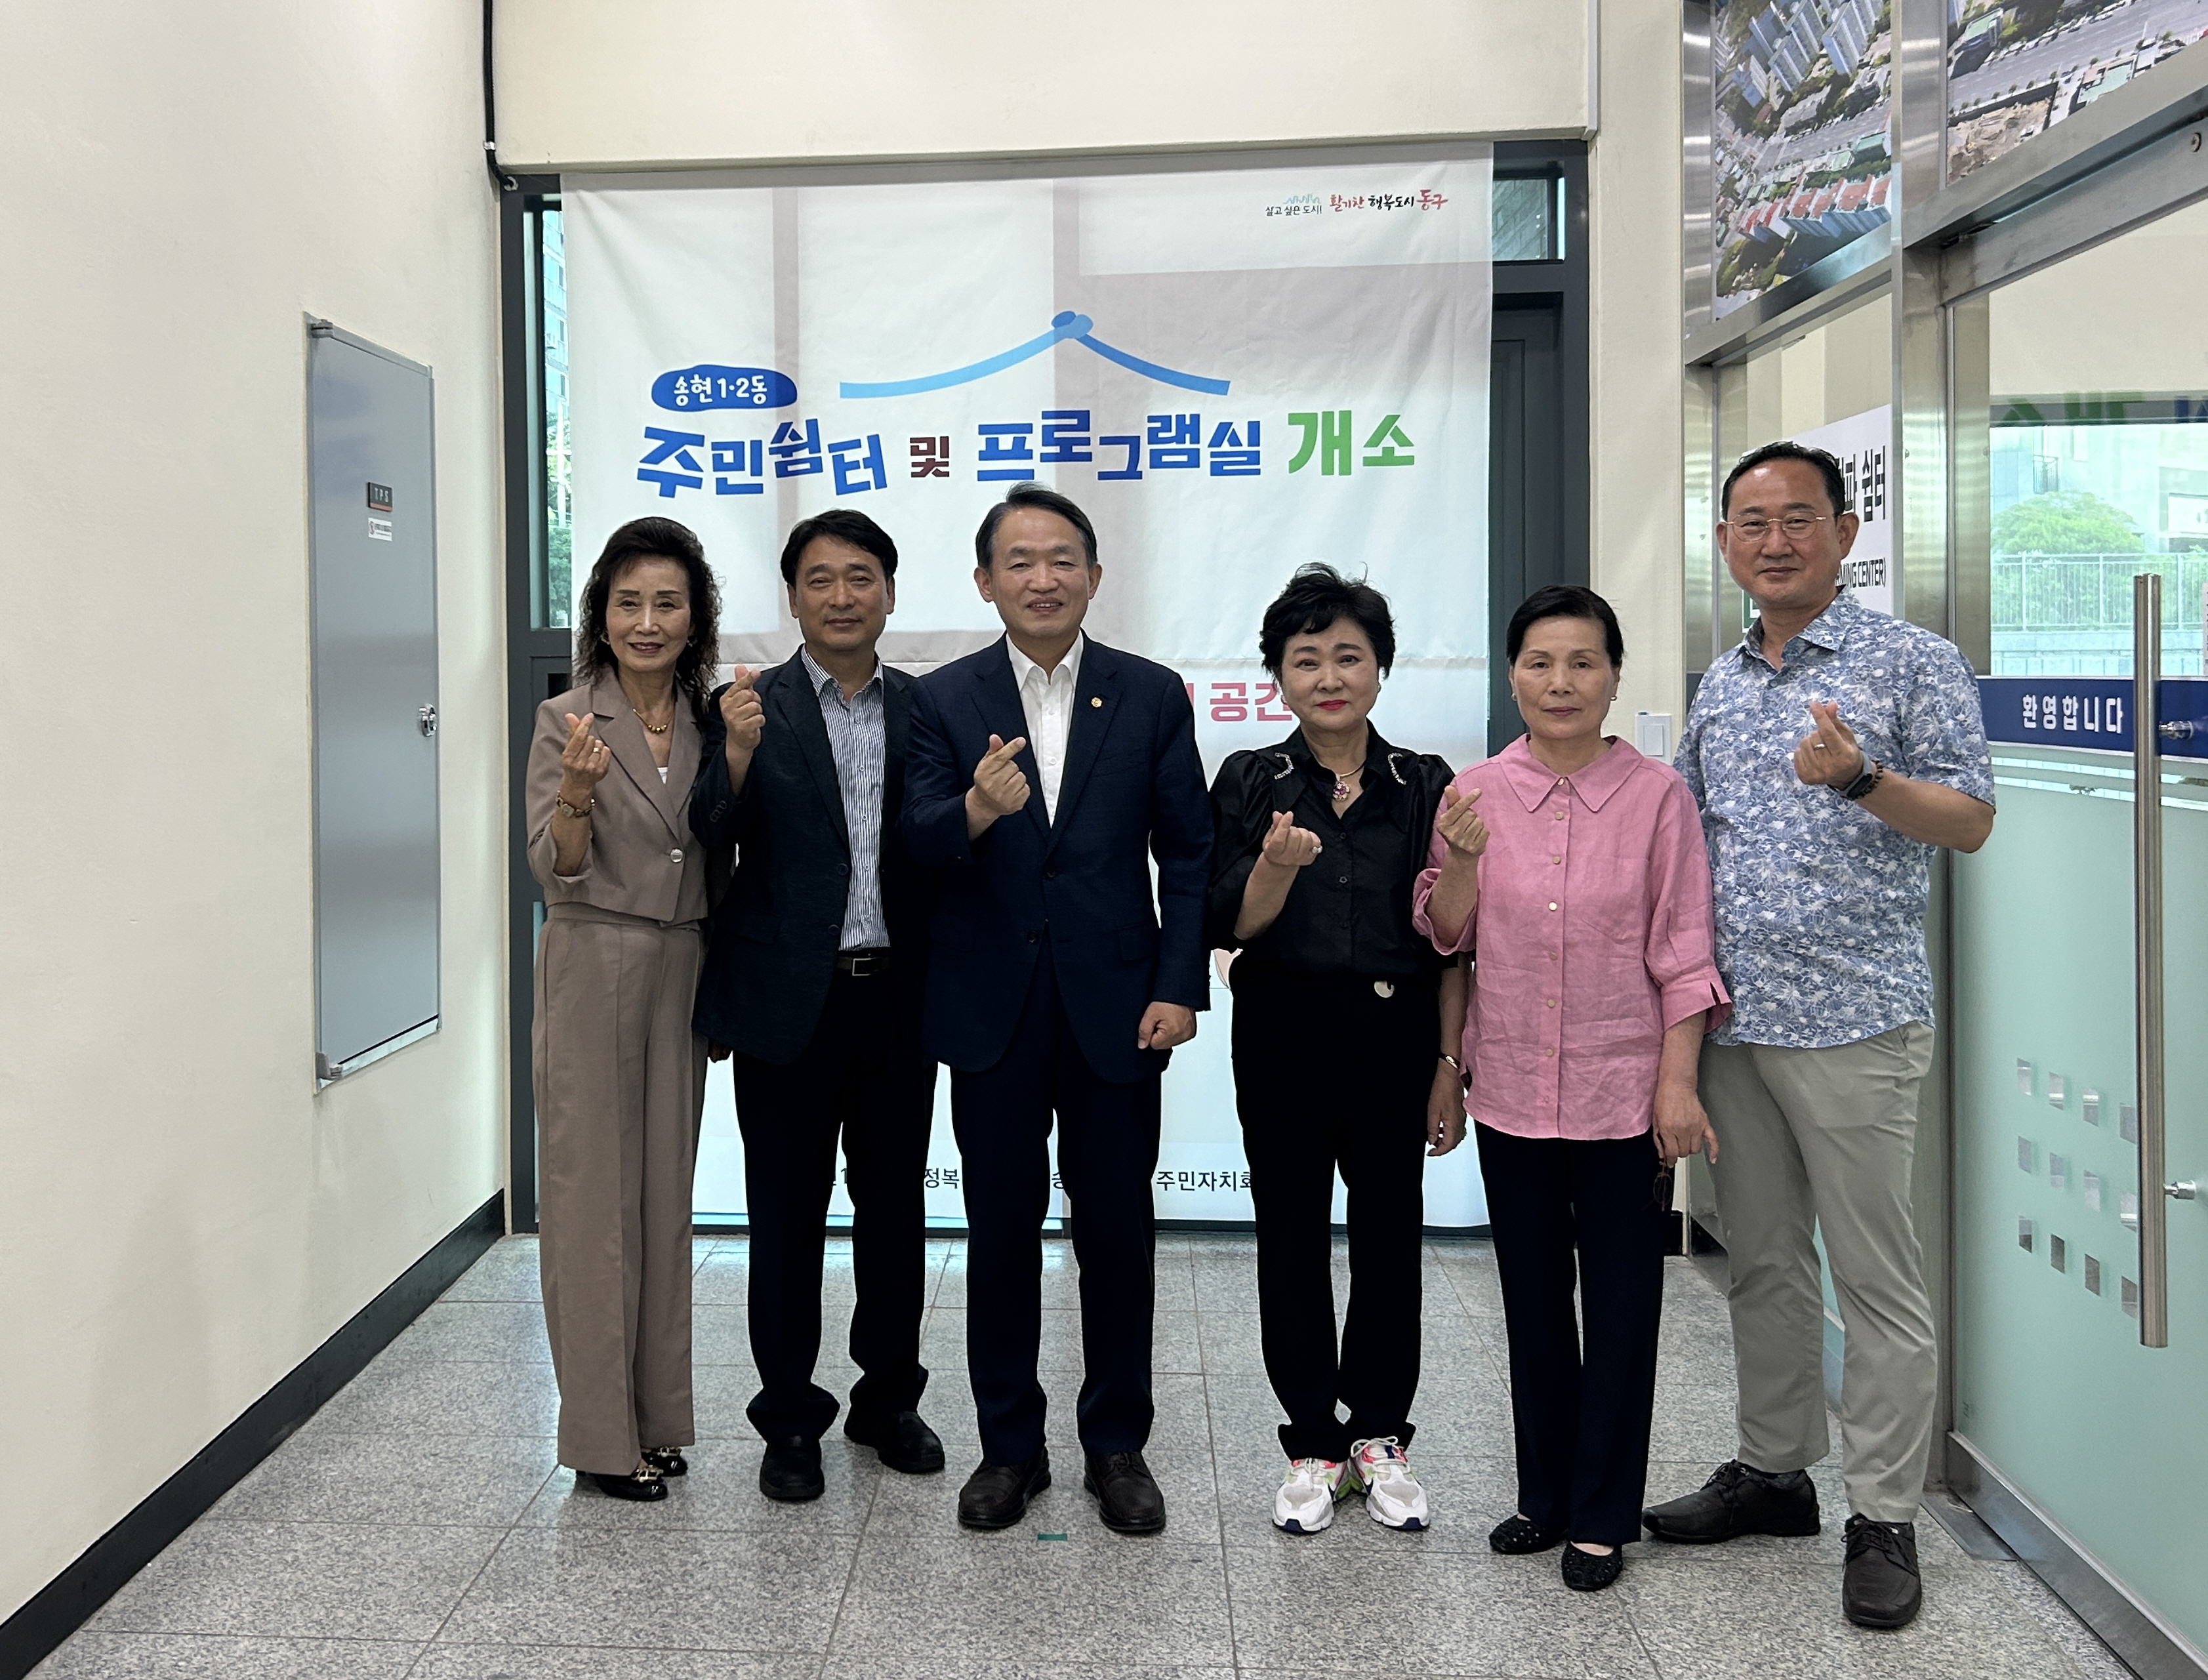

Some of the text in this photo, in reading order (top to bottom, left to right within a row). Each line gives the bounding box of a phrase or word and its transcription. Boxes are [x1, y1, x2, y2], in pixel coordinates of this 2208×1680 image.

[1265, 206, 1282, 216] 살고
[1284, 205, 1301, 216] 싶은
[1330, 190, 1448, 212] 활기찬 행복도시 동구
[637, 410, 1415, 499] 주민쉼터 및 프로그램실 개소
[1862, 445, 1886, 522] 쉼터
[2022, 694, 2123, 734] 환영합니다
[925, 1168, 960, 1189] 정복
